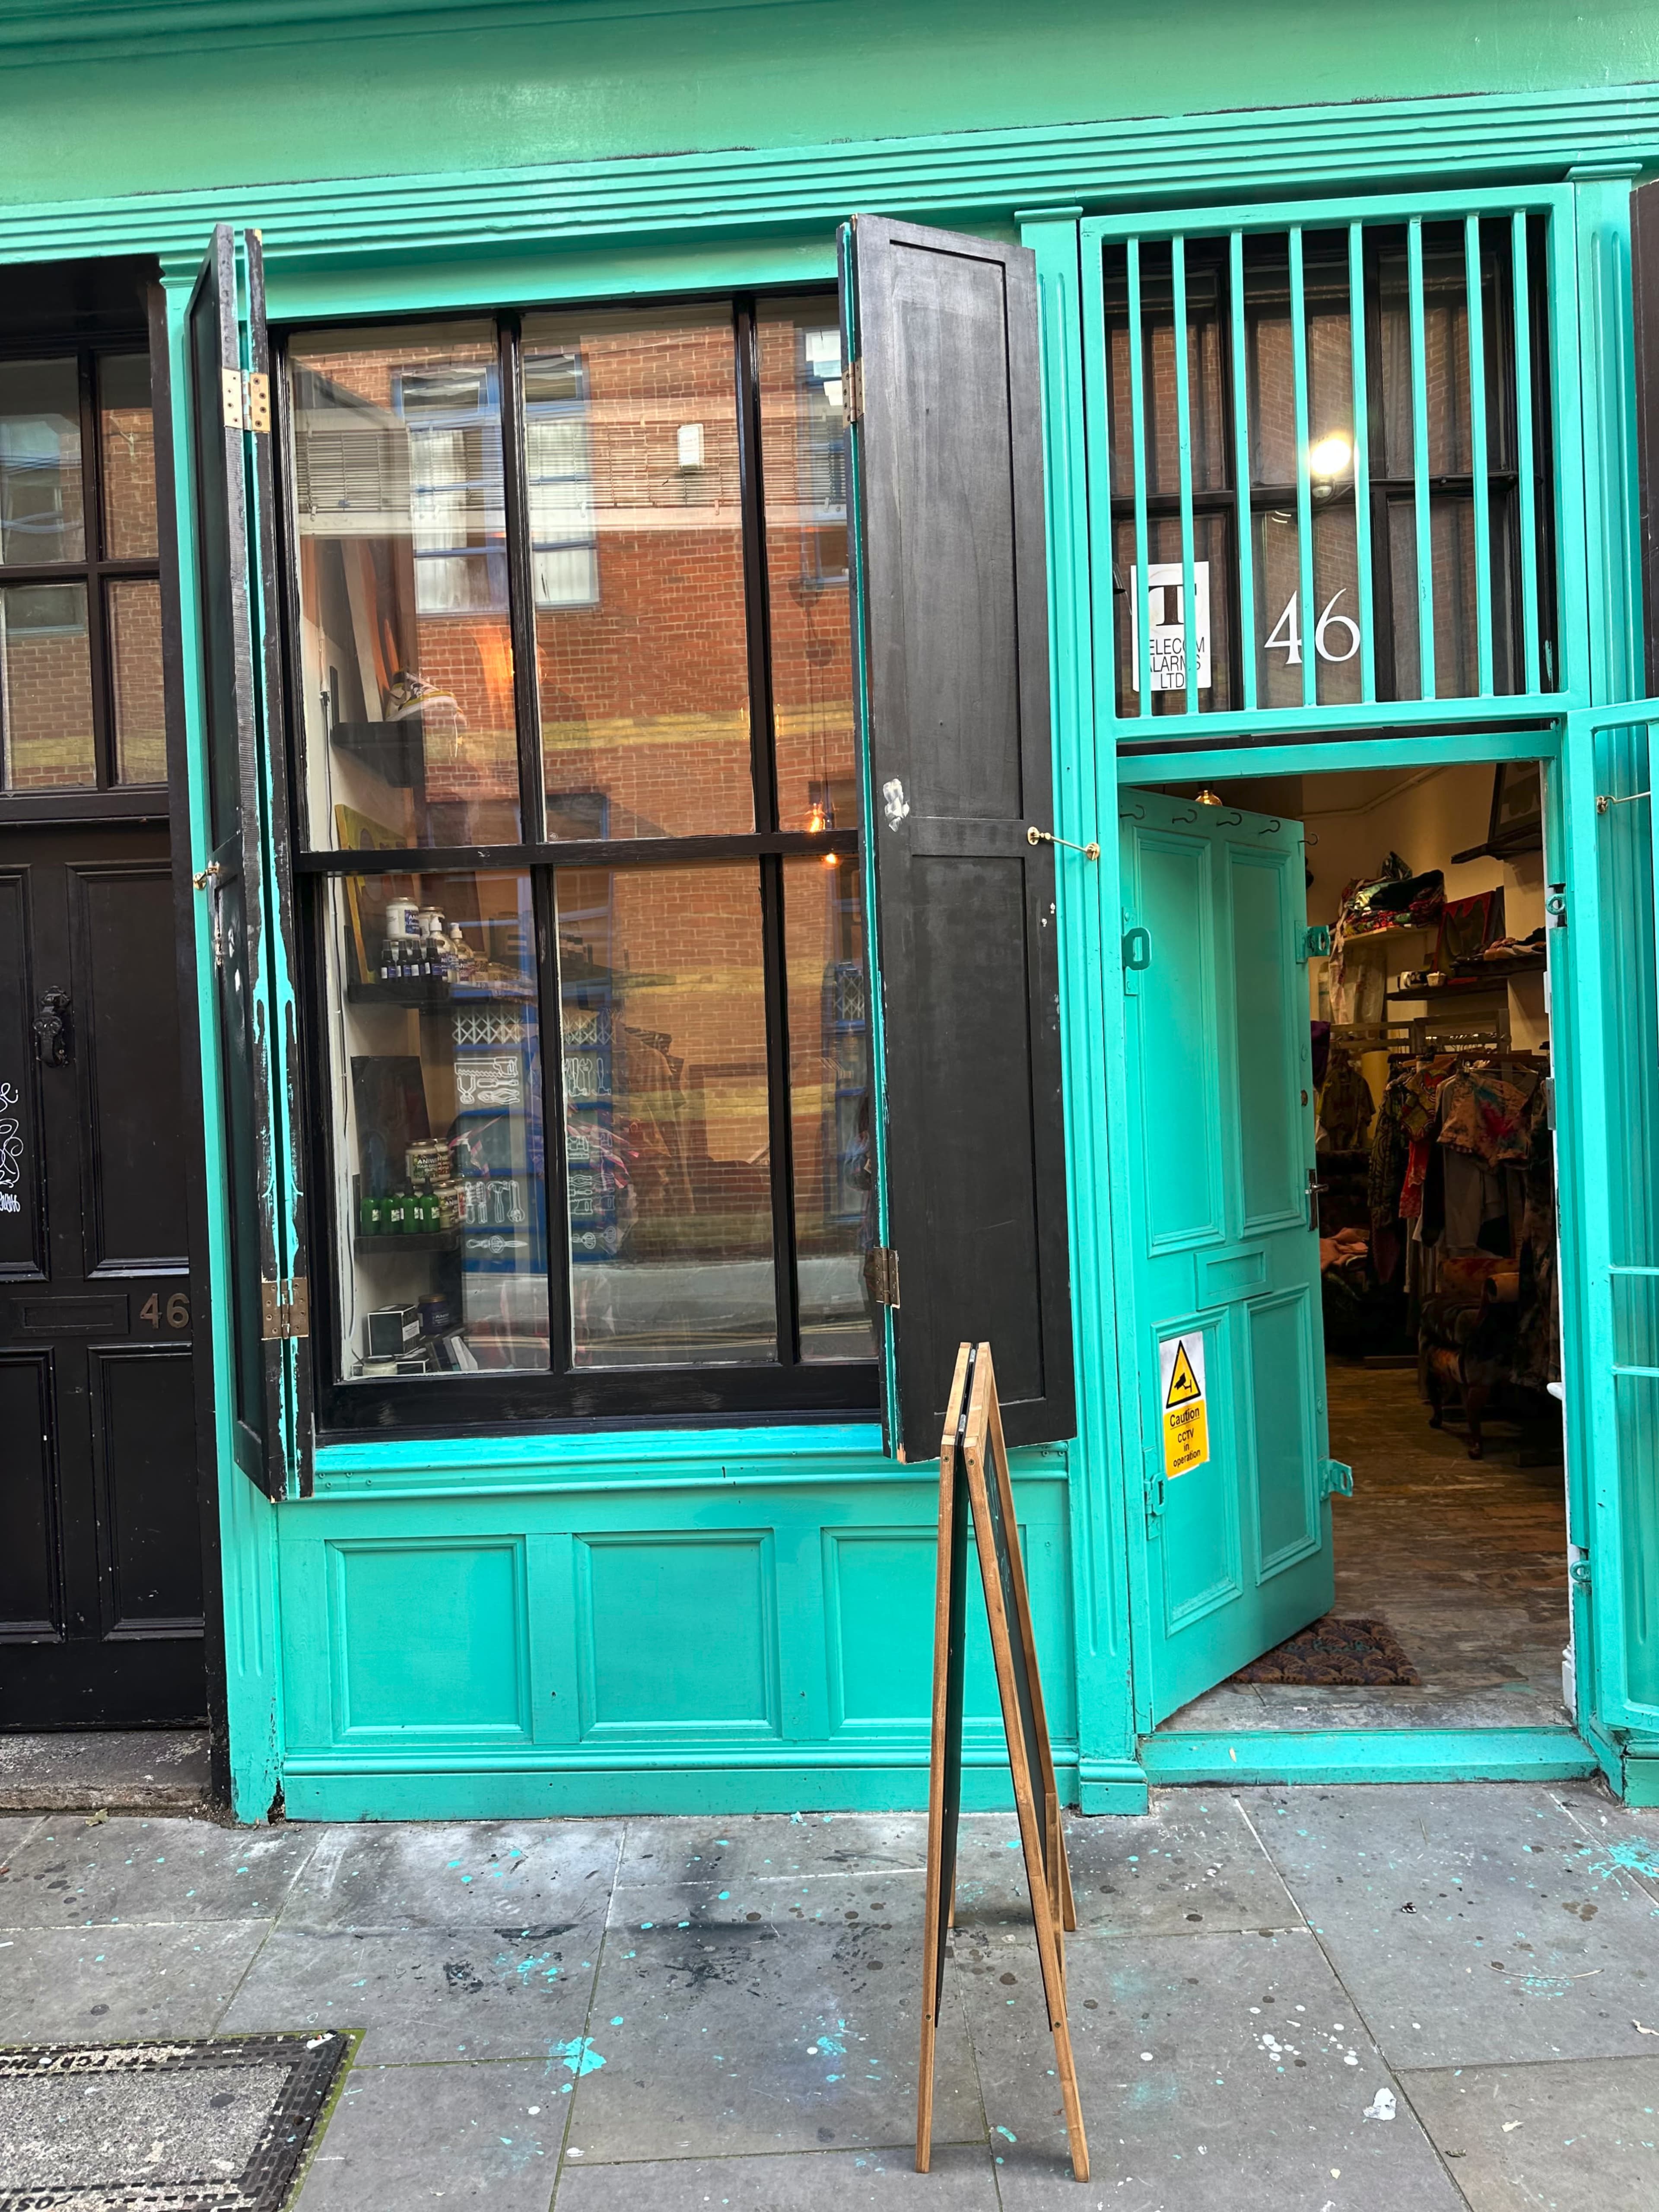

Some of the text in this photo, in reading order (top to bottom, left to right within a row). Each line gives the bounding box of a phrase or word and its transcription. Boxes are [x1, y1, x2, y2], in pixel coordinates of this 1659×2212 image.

[1148, 584, 1197, 626] T
[1264, 588, 1360, 664] 46
[1149, 637, 1205, 655] ELECM
[1160, 673, 1185, 689] LTD
[140, 1292, 190, 1329] 46
[1170, 1407, 1200, 1427] Caution
[1177, 1428, 1194, 1443] CCTV
[1183, 1443, 1189, 1452] in
[1173, 1449, 1201, 1468] operation
